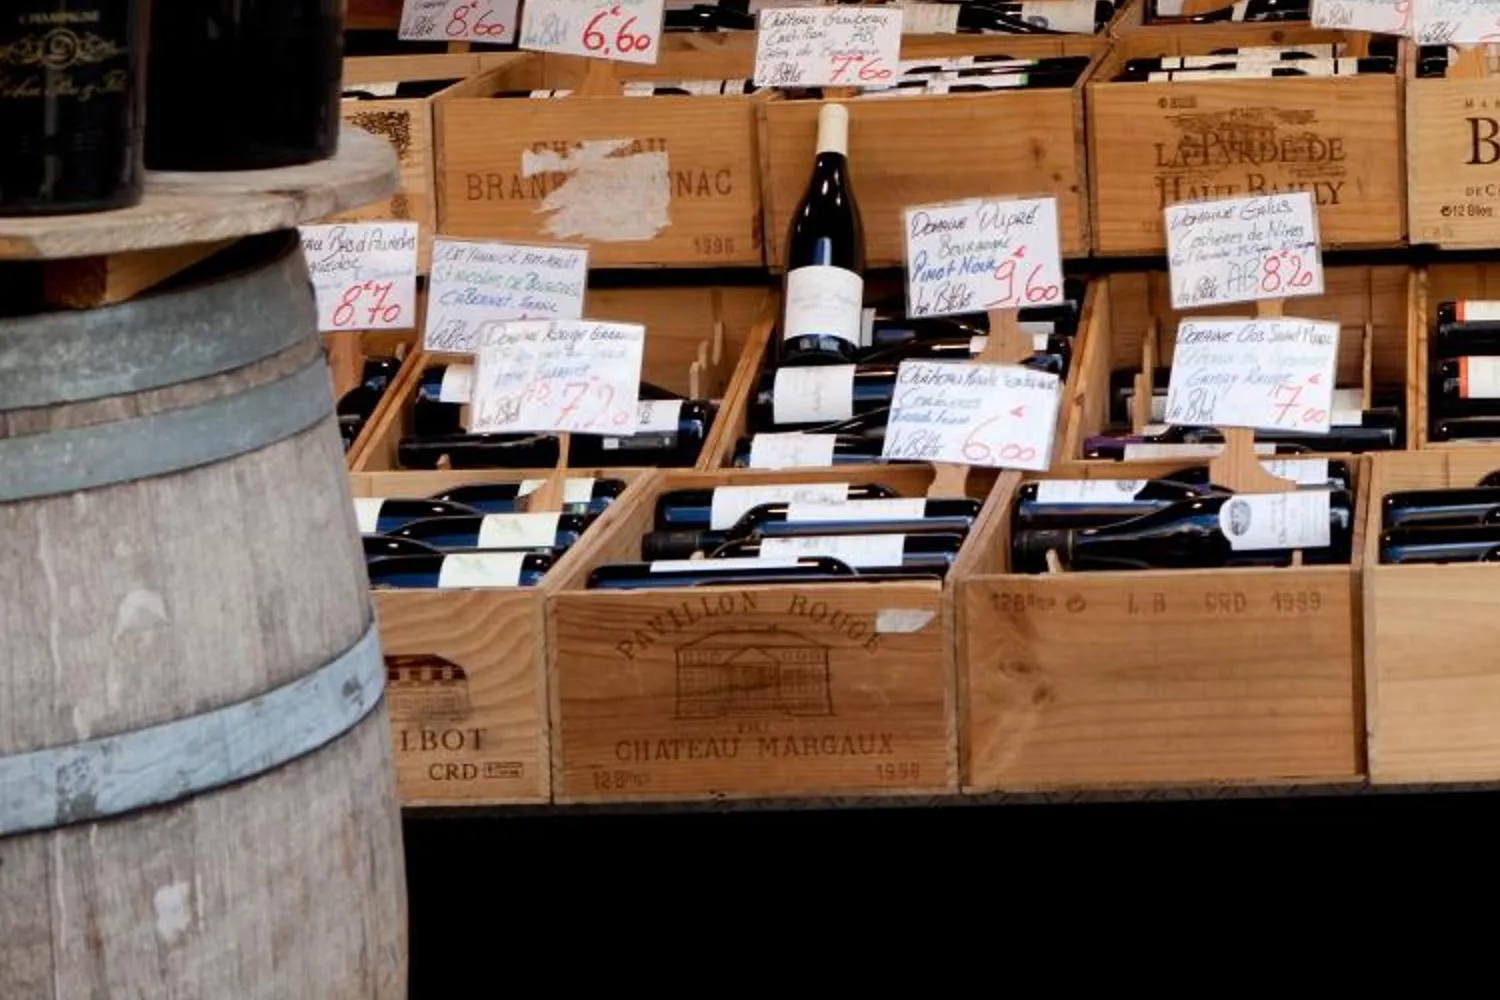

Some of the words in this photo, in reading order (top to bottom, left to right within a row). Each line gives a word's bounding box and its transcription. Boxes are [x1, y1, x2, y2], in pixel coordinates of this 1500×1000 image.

[400, 726, 488, 752] LBOT
[613, 737, 741, 762] CHATEAU
[756, 732, 897, 758] MARGAUX
[427, 763, 479, 782] CRD
